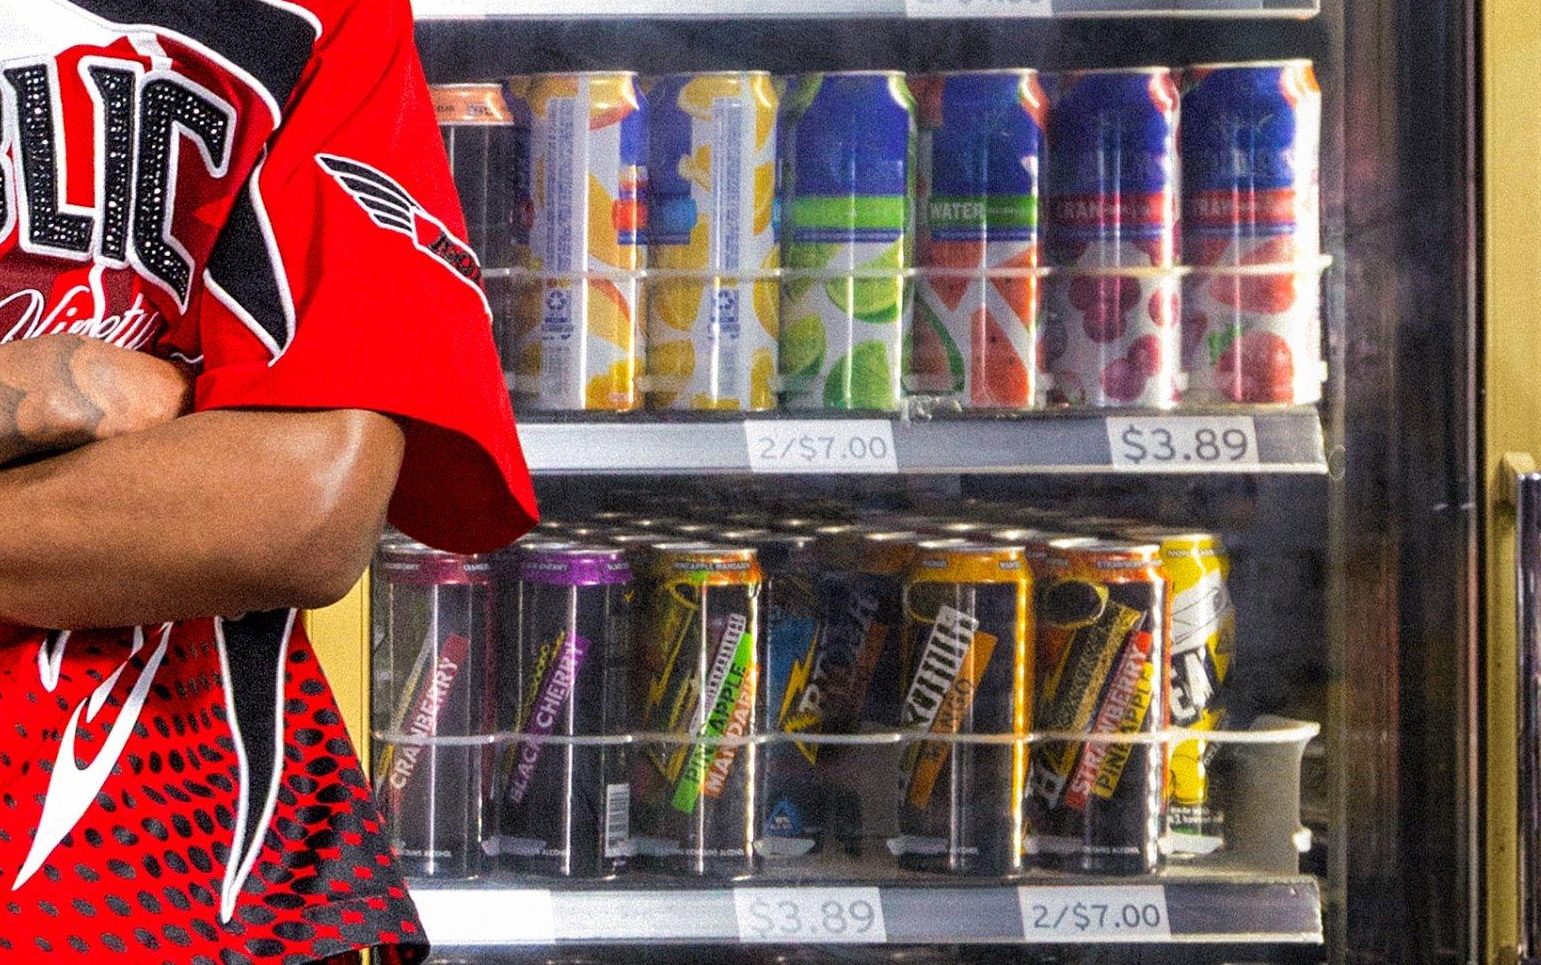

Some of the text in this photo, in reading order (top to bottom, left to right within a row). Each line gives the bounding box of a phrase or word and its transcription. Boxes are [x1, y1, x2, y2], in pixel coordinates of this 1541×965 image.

[757, 437, 888, 462] 2/$7.00
[1121, 424, 1249, 463] $3.89
[749, 899, 875, 935] $3.89
[1031, 903, 1162, 929] 2/$7.00
